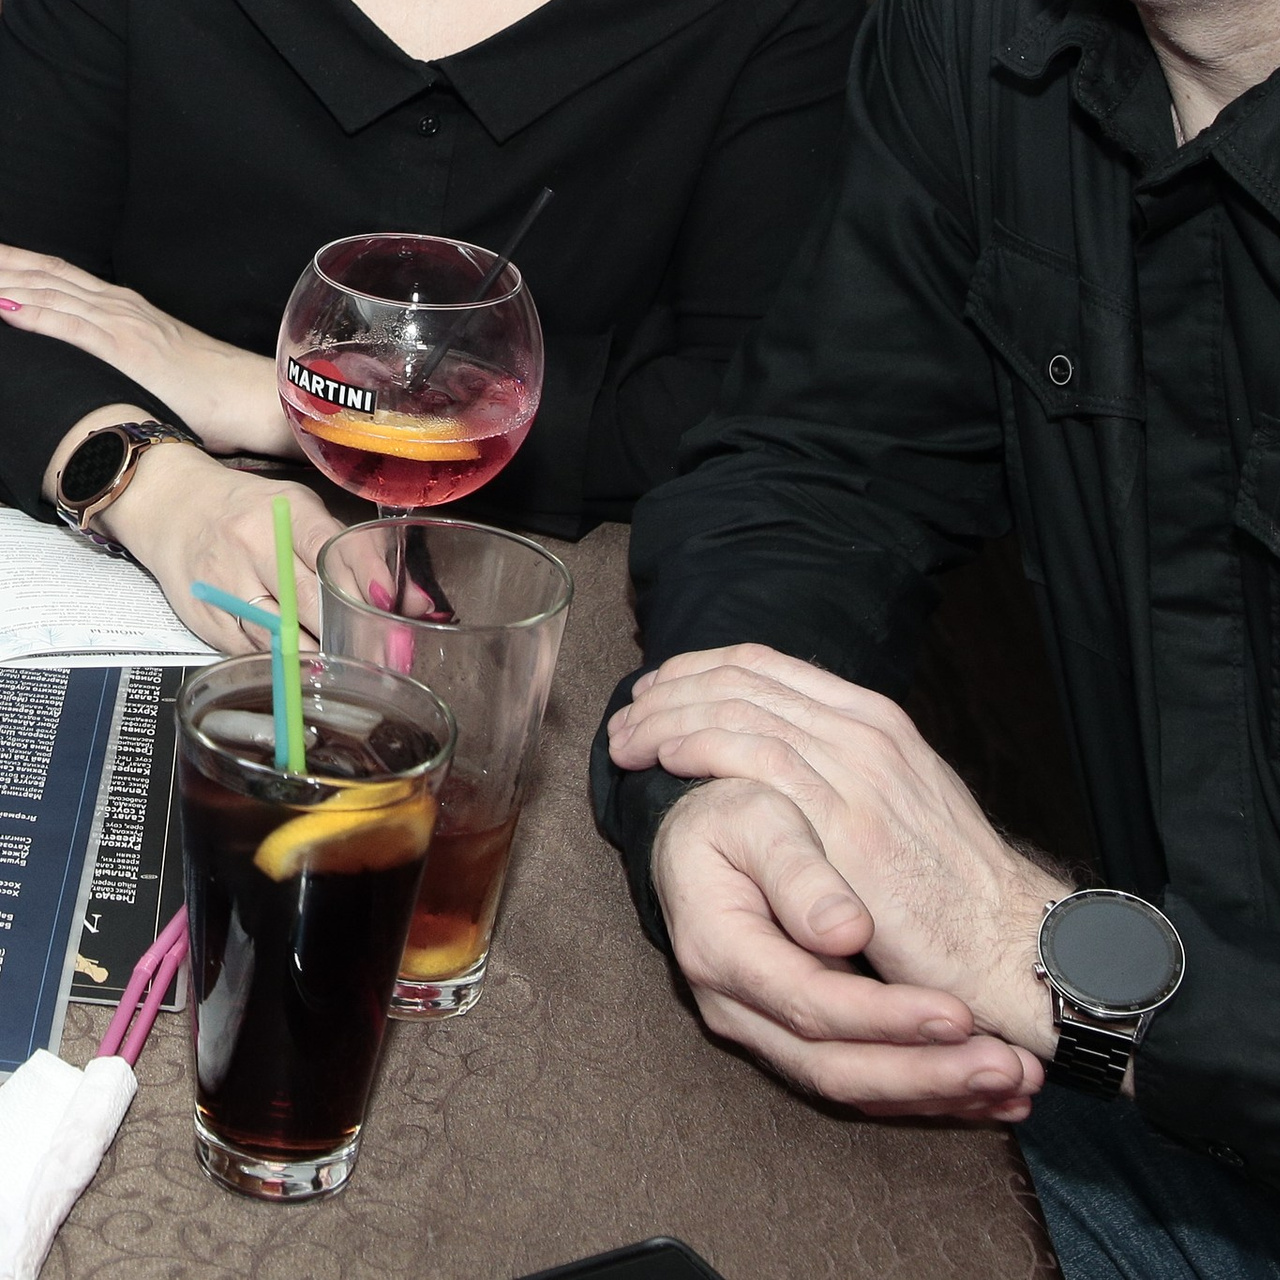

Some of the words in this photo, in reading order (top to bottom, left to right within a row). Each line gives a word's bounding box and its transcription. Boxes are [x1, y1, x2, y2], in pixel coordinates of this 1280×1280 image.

[288, 361, 372, 412] MARTINI
[17, 728, 56, 740] Апероль
[29, 743, 53, 752] Пина
[13, 753, 29, 762] Тай
[30, 755, 50, 764] Май
[15, 765, 47, 776] Текила
[12, 775, 45, 787] Белуга
[0, 787, 42, 800] Мартини
[106, 783, 148, 796] Теплый
[111, 812, 145, 823] Салат
[1, 849, 29, 859] Джек
[117, 863, 139, 872] Микс
[94, 868, 138, 880] Теплый
[94, 891, 135, 904] Гнездо
